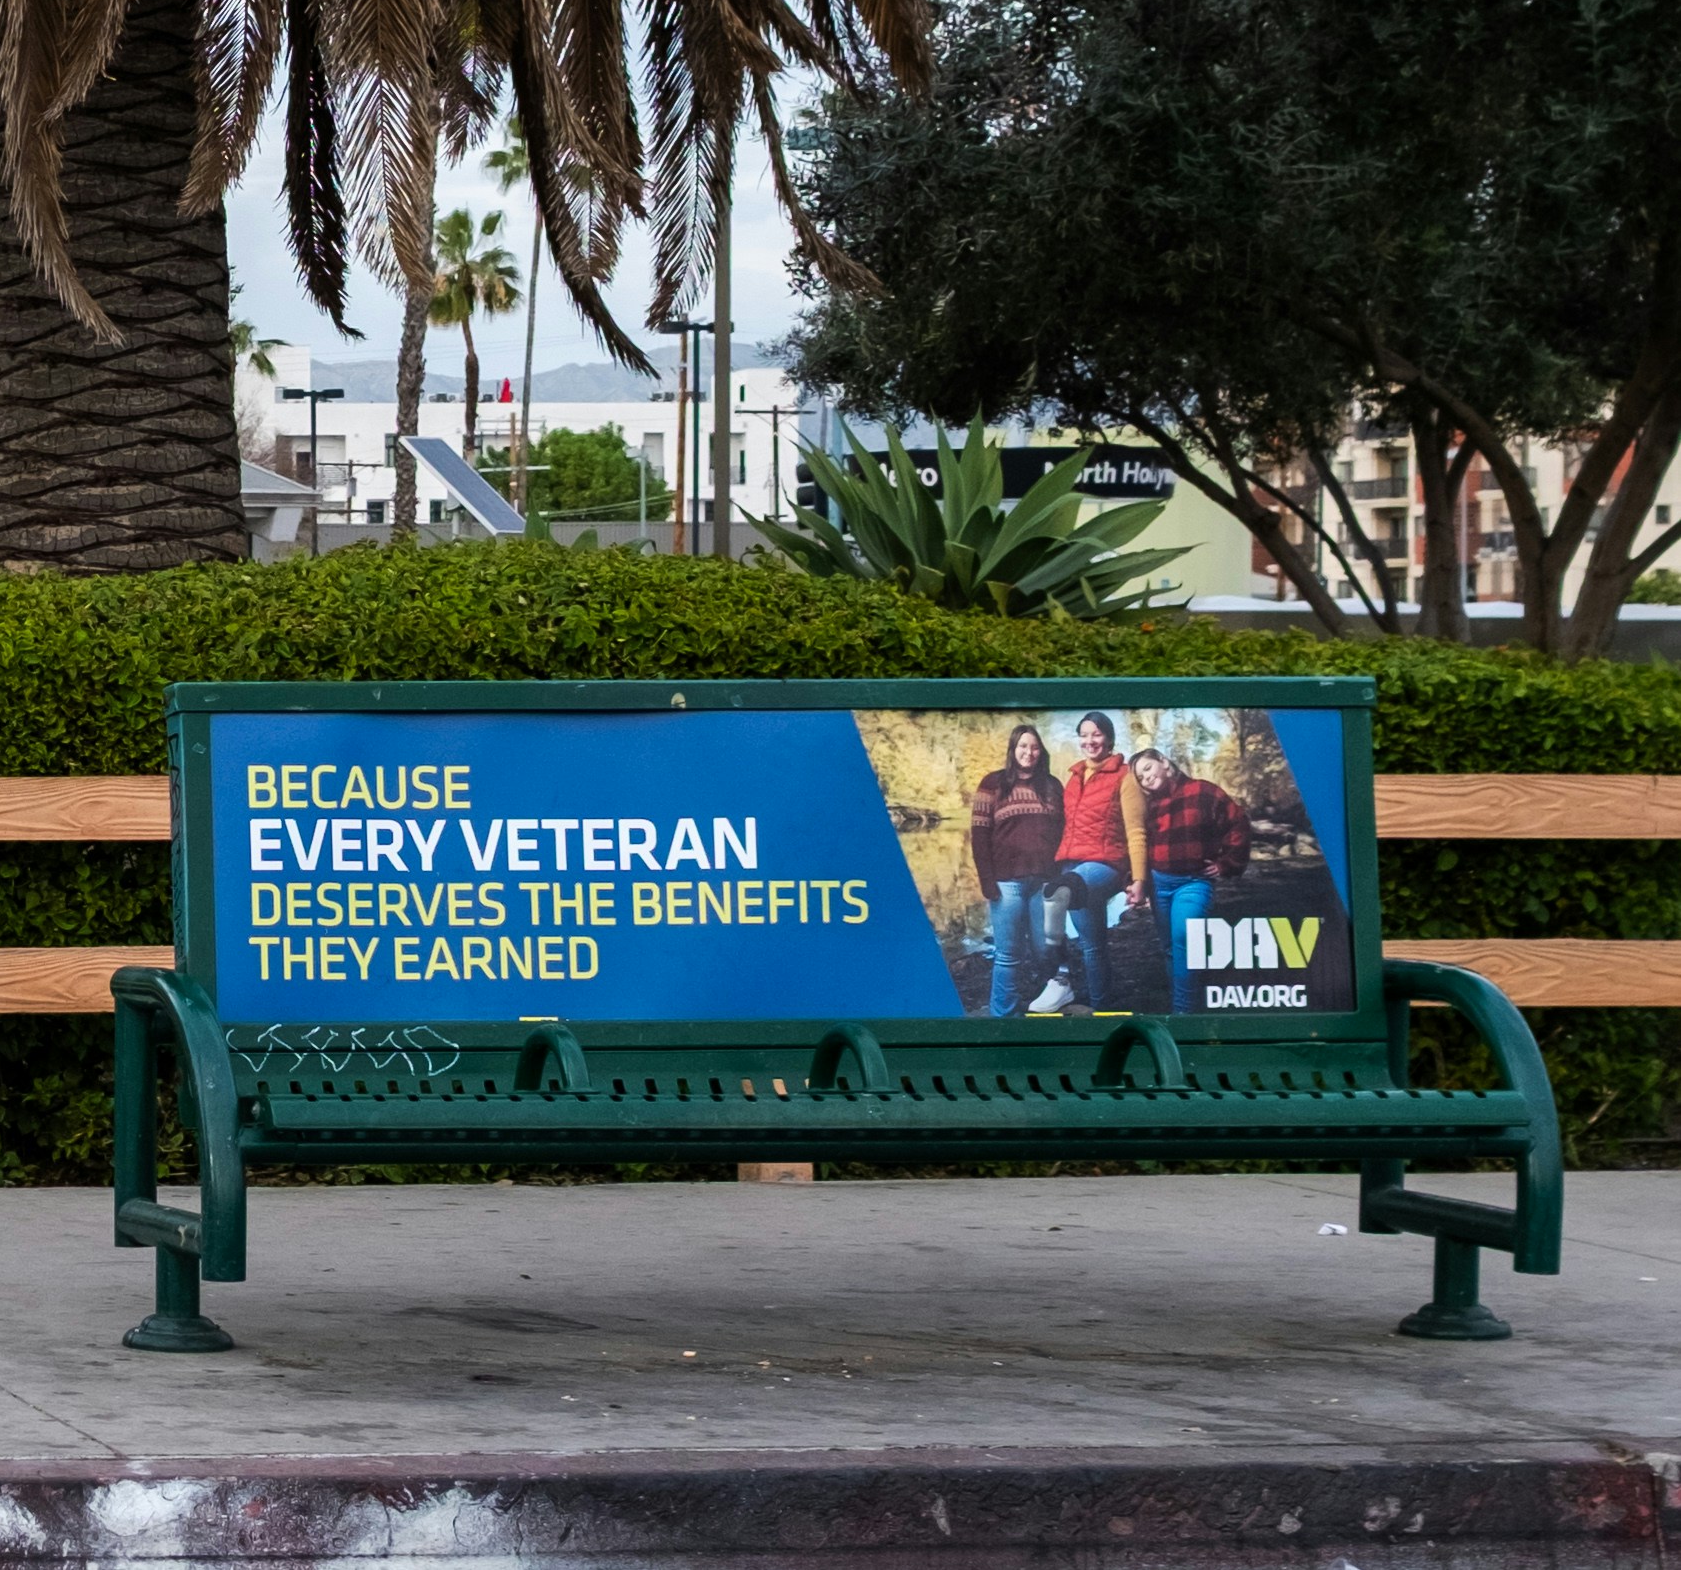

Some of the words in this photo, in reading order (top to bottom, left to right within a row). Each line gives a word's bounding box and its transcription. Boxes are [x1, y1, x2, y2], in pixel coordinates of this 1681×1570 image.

[247, 764, 472, 810] BECAUSE
[249, 818, 446, 873] EVERY
[458, 817, 758, 872] VETERAN
[250, 881, 506, 927] DESERVES
[518, 881, 617, 926] THE
[631, 879, 869, 926] BENEFITS
[248, 936, 380, 981] THEY
[393, 935, 599, 981] EARNED
[1185, 917, 1321, 970] DAV
[1206, 984, 1308, 1009] DAV.ORG
